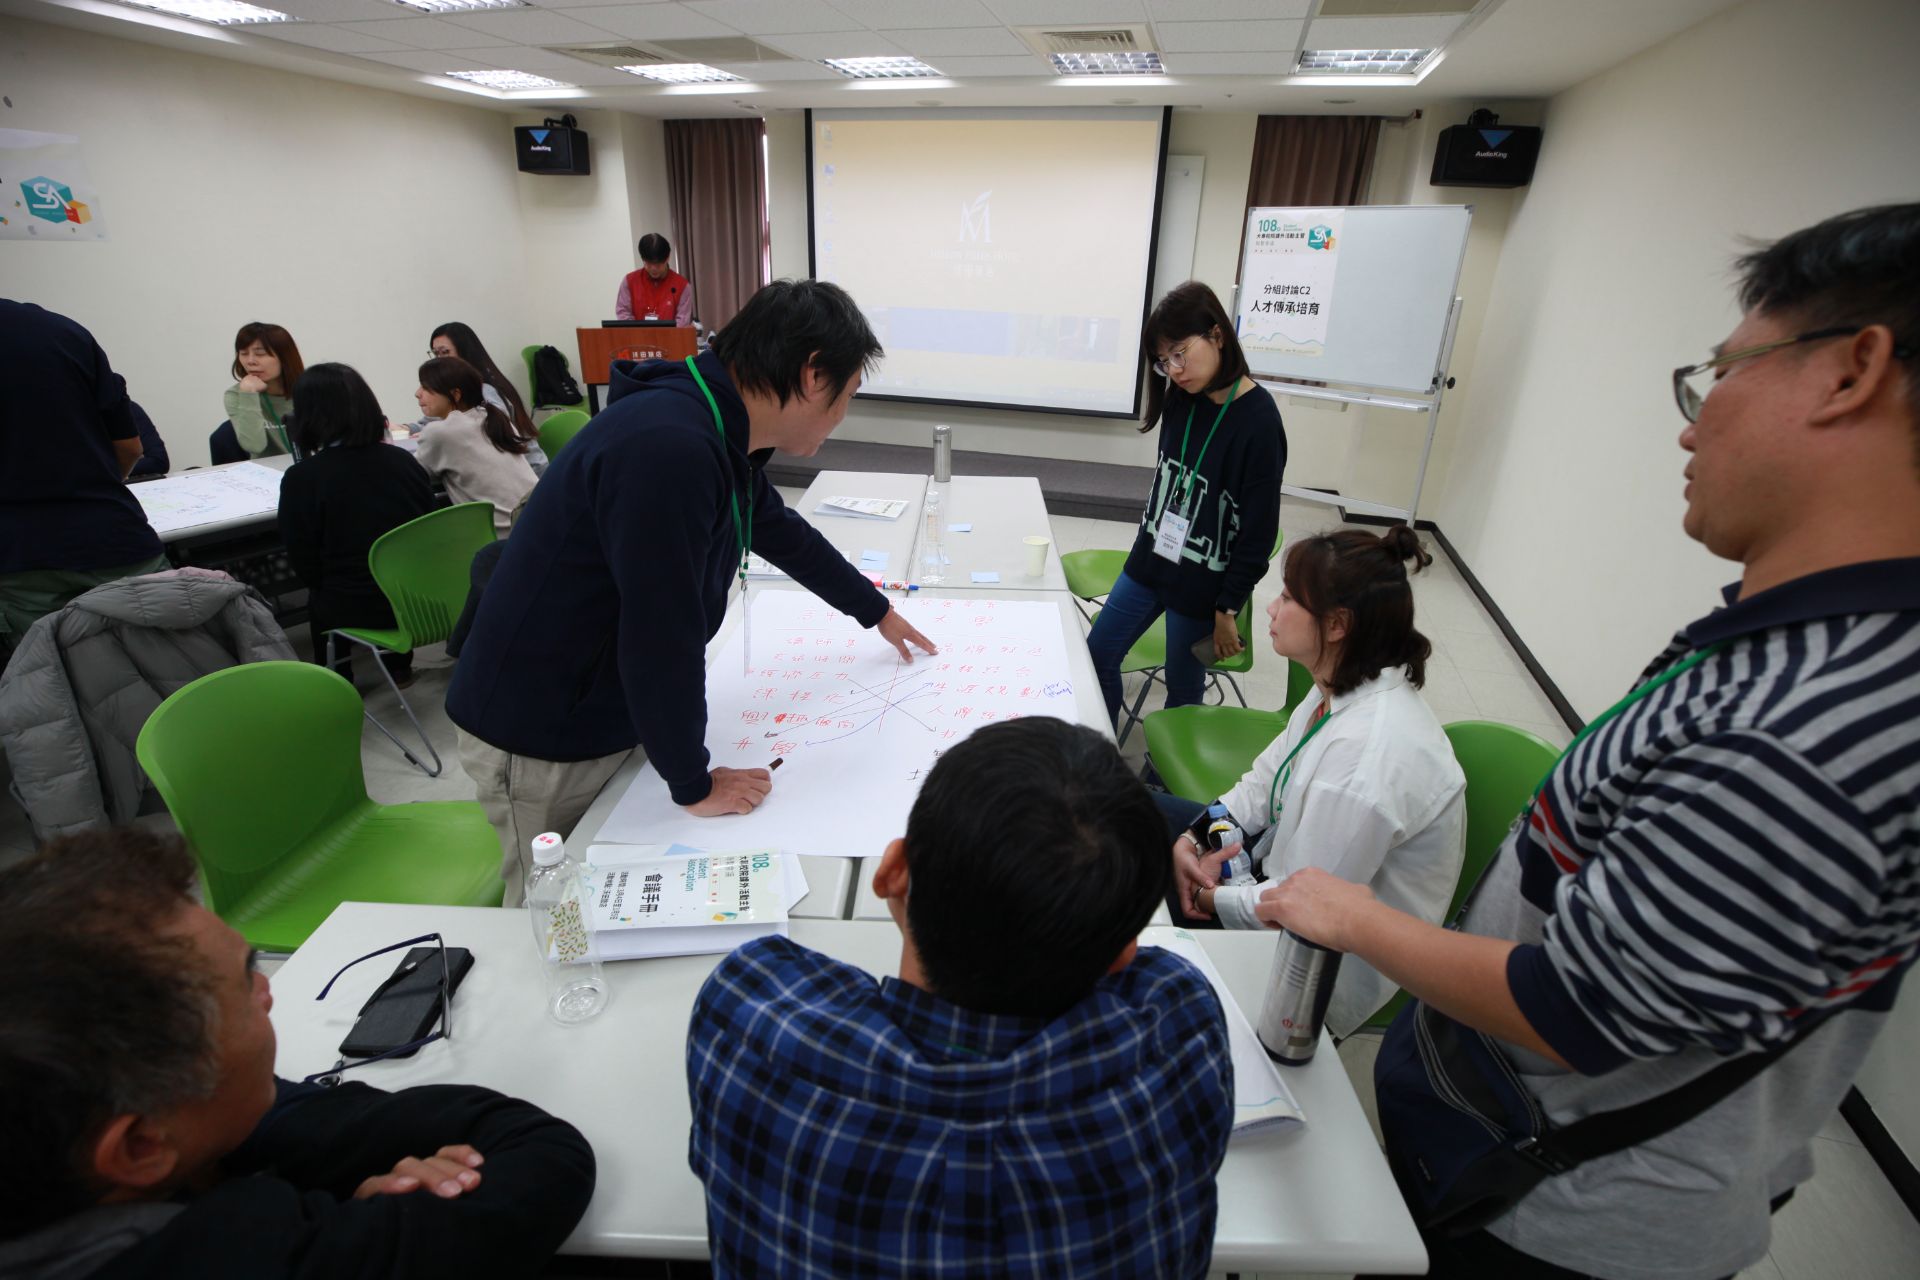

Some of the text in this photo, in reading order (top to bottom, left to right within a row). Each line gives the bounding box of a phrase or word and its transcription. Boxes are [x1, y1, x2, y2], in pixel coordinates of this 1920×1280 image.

[1475, 150, 1508, 159] AudioKing
[1263, 284, 1311, 295] 分組討論C2
[1250, 300, 1320, 315] 人才傳承培育
[685, 858, 697, 891] Association
[698, 857, 710, 879] Student
[638, 872, 664, 913] 會議手冊
